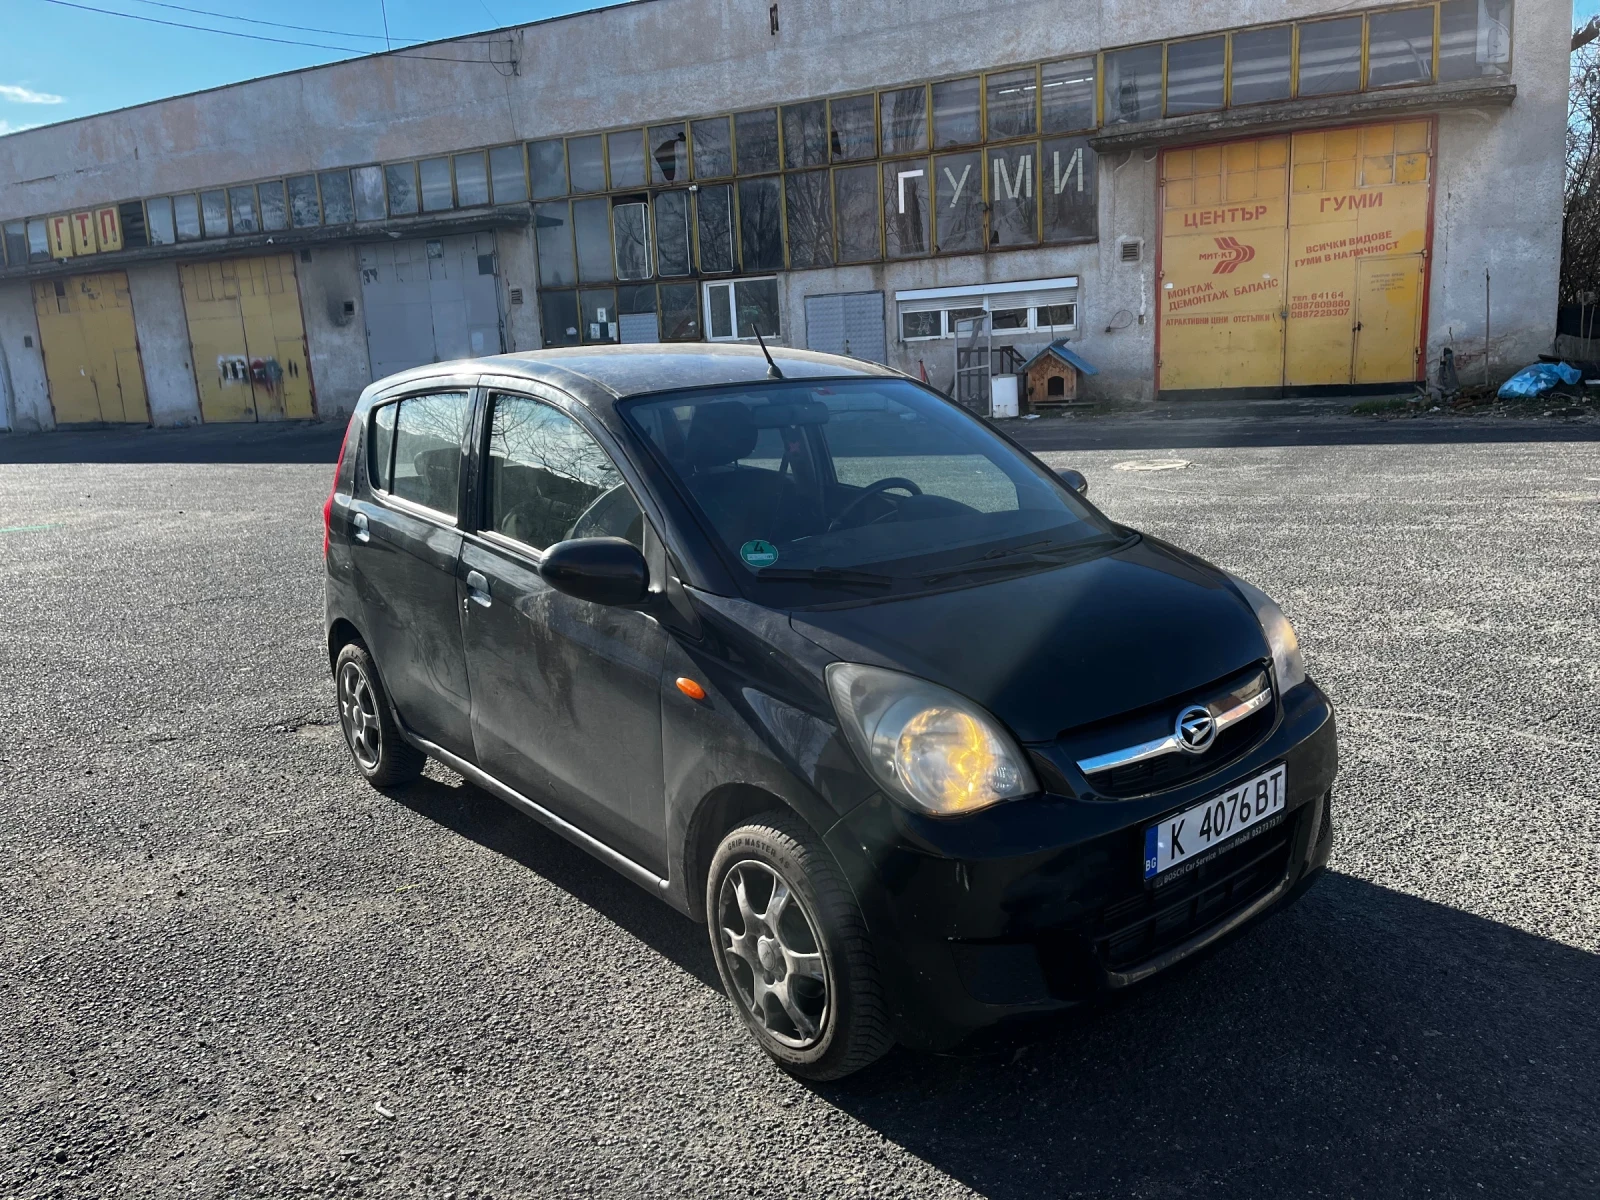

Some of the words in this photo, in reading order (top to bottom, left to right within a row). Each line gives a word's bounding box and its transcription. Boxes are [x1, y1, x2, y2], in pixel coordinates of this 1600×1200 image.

[898, 148, 1084, 214] ГУМИ
[1320, 192, 1383, 213] ГУМИ
[1184, 205, 1268, 229] ЦЕНТЪР
[54, 209, 118, 252] ГТП
[1305, 239, 1347, 254] ВСИЧКИ
[1349, 230, 1393, 246] ВИДОВЕ
[1199, 251, 1233, 261] МИТ-КТ
[1295, 257, 1322, 268] ГУМИ
[1324, 254, 1331, 262] В
[1333, 240, 1400, 261] НАЛИЧНОСТ
[1167, 281, 1214, 300] МОНТАЖ
[1169, 290, 1229, 312] ДЕМОНТАЖ
[1311, 291, 1344, 301] 64164
[1166, 317, 1209, 327] АТРАКТИВНИ
[1211, 315, 1229, 325] ЦЕНИ
[1233, 314, 1270, 324] ОТСТЪПКИ
[754, 541, 765, 553] 4
[727, 838, 742, 851] GRIP
[744, 838, 776, 858] MASTER
[1171, 819, 1185, 861] K
[1145, 857, 1157, 872] BG
[1163, 867, 1185, 884] BOSCH
[1185, 862, 1196, 872] Car
[1196, 851, 1217, 868] Service
